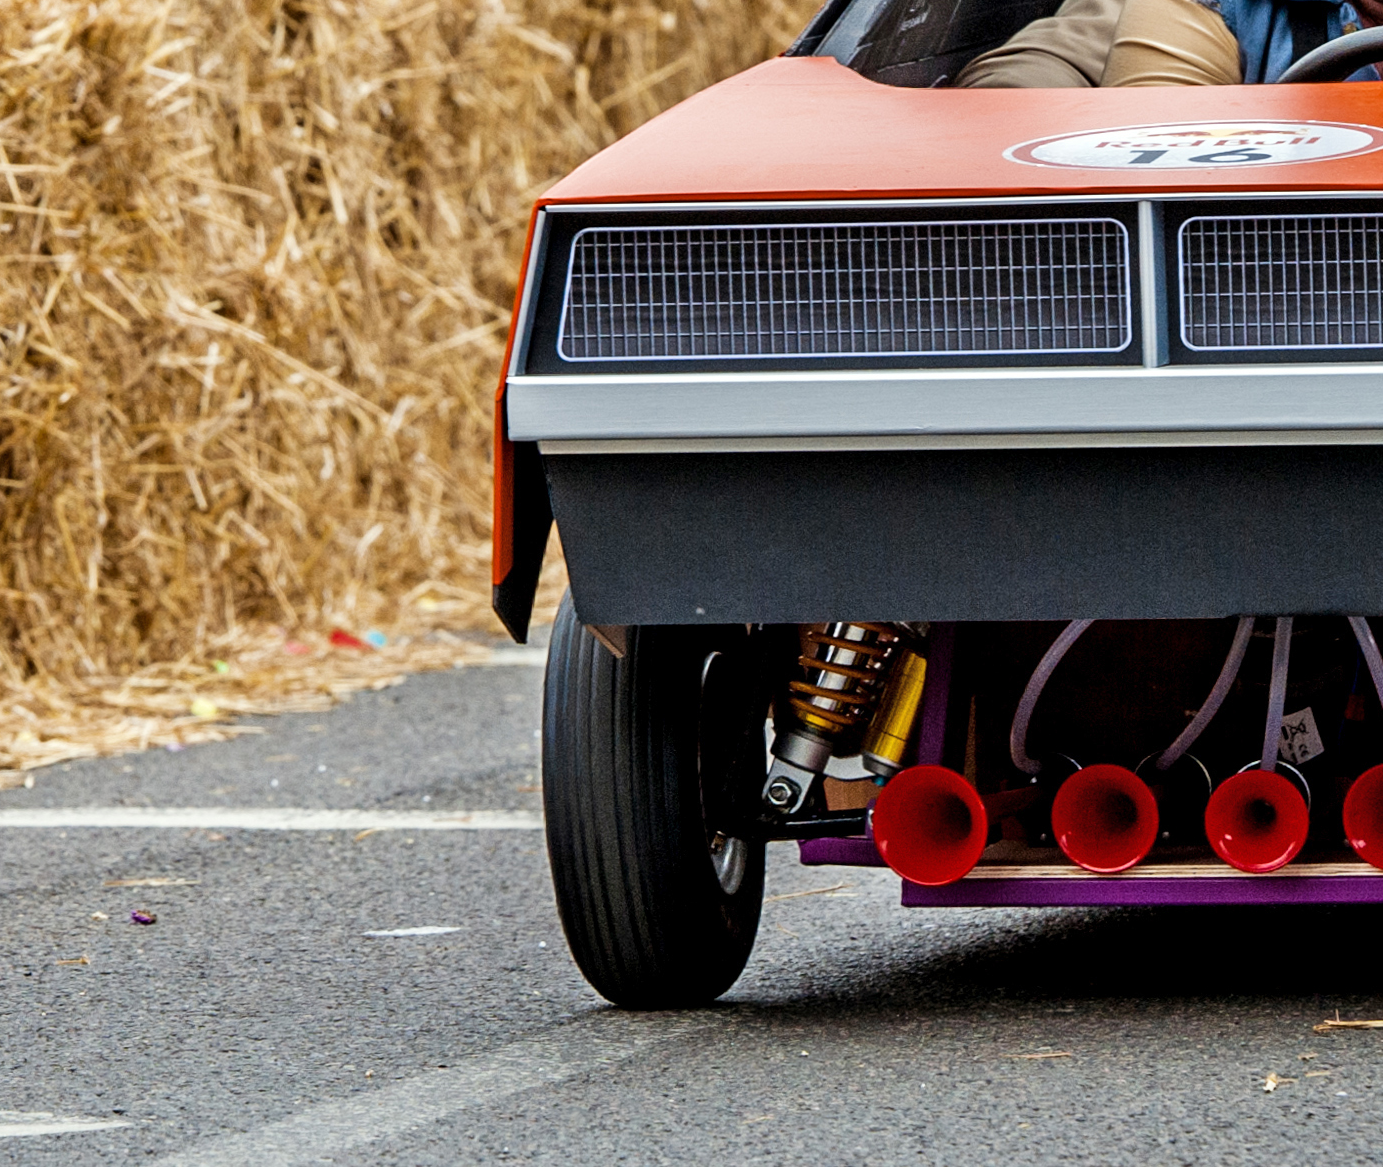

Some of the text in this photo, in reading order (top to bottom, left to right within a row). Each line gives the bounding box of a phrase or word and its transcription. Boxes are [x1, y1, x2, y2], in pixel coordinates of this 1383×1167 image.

[1095, 136, 1321, 148] Red Bull
[1127, 147, 1273, 165] 16
